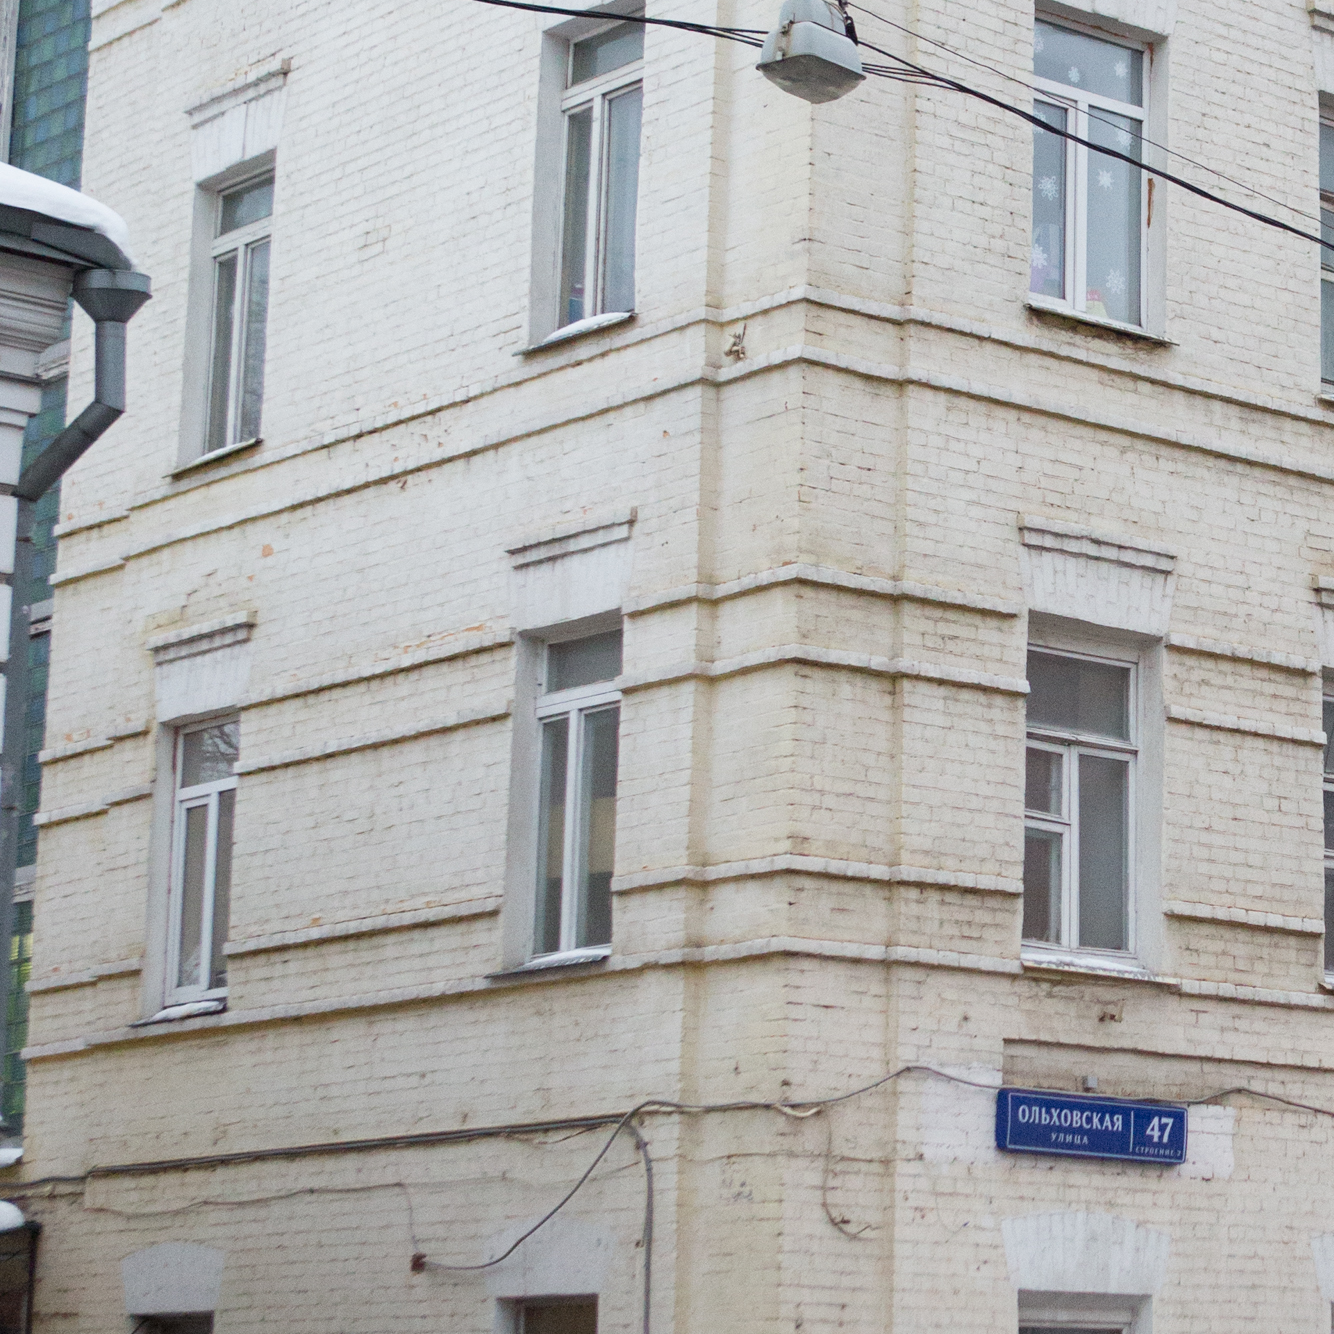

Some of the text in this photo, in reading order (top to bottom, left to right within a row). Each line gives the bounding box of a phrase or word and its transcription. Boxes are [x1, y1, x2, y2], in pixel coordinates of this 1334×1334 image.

[1018, 1104, 1123, 1132] ОЛЬХОВСКАЯ
[1145, 1115, 1174, 1144] 47
[1050, 1132, 1089, 1145] УЛИЦА
